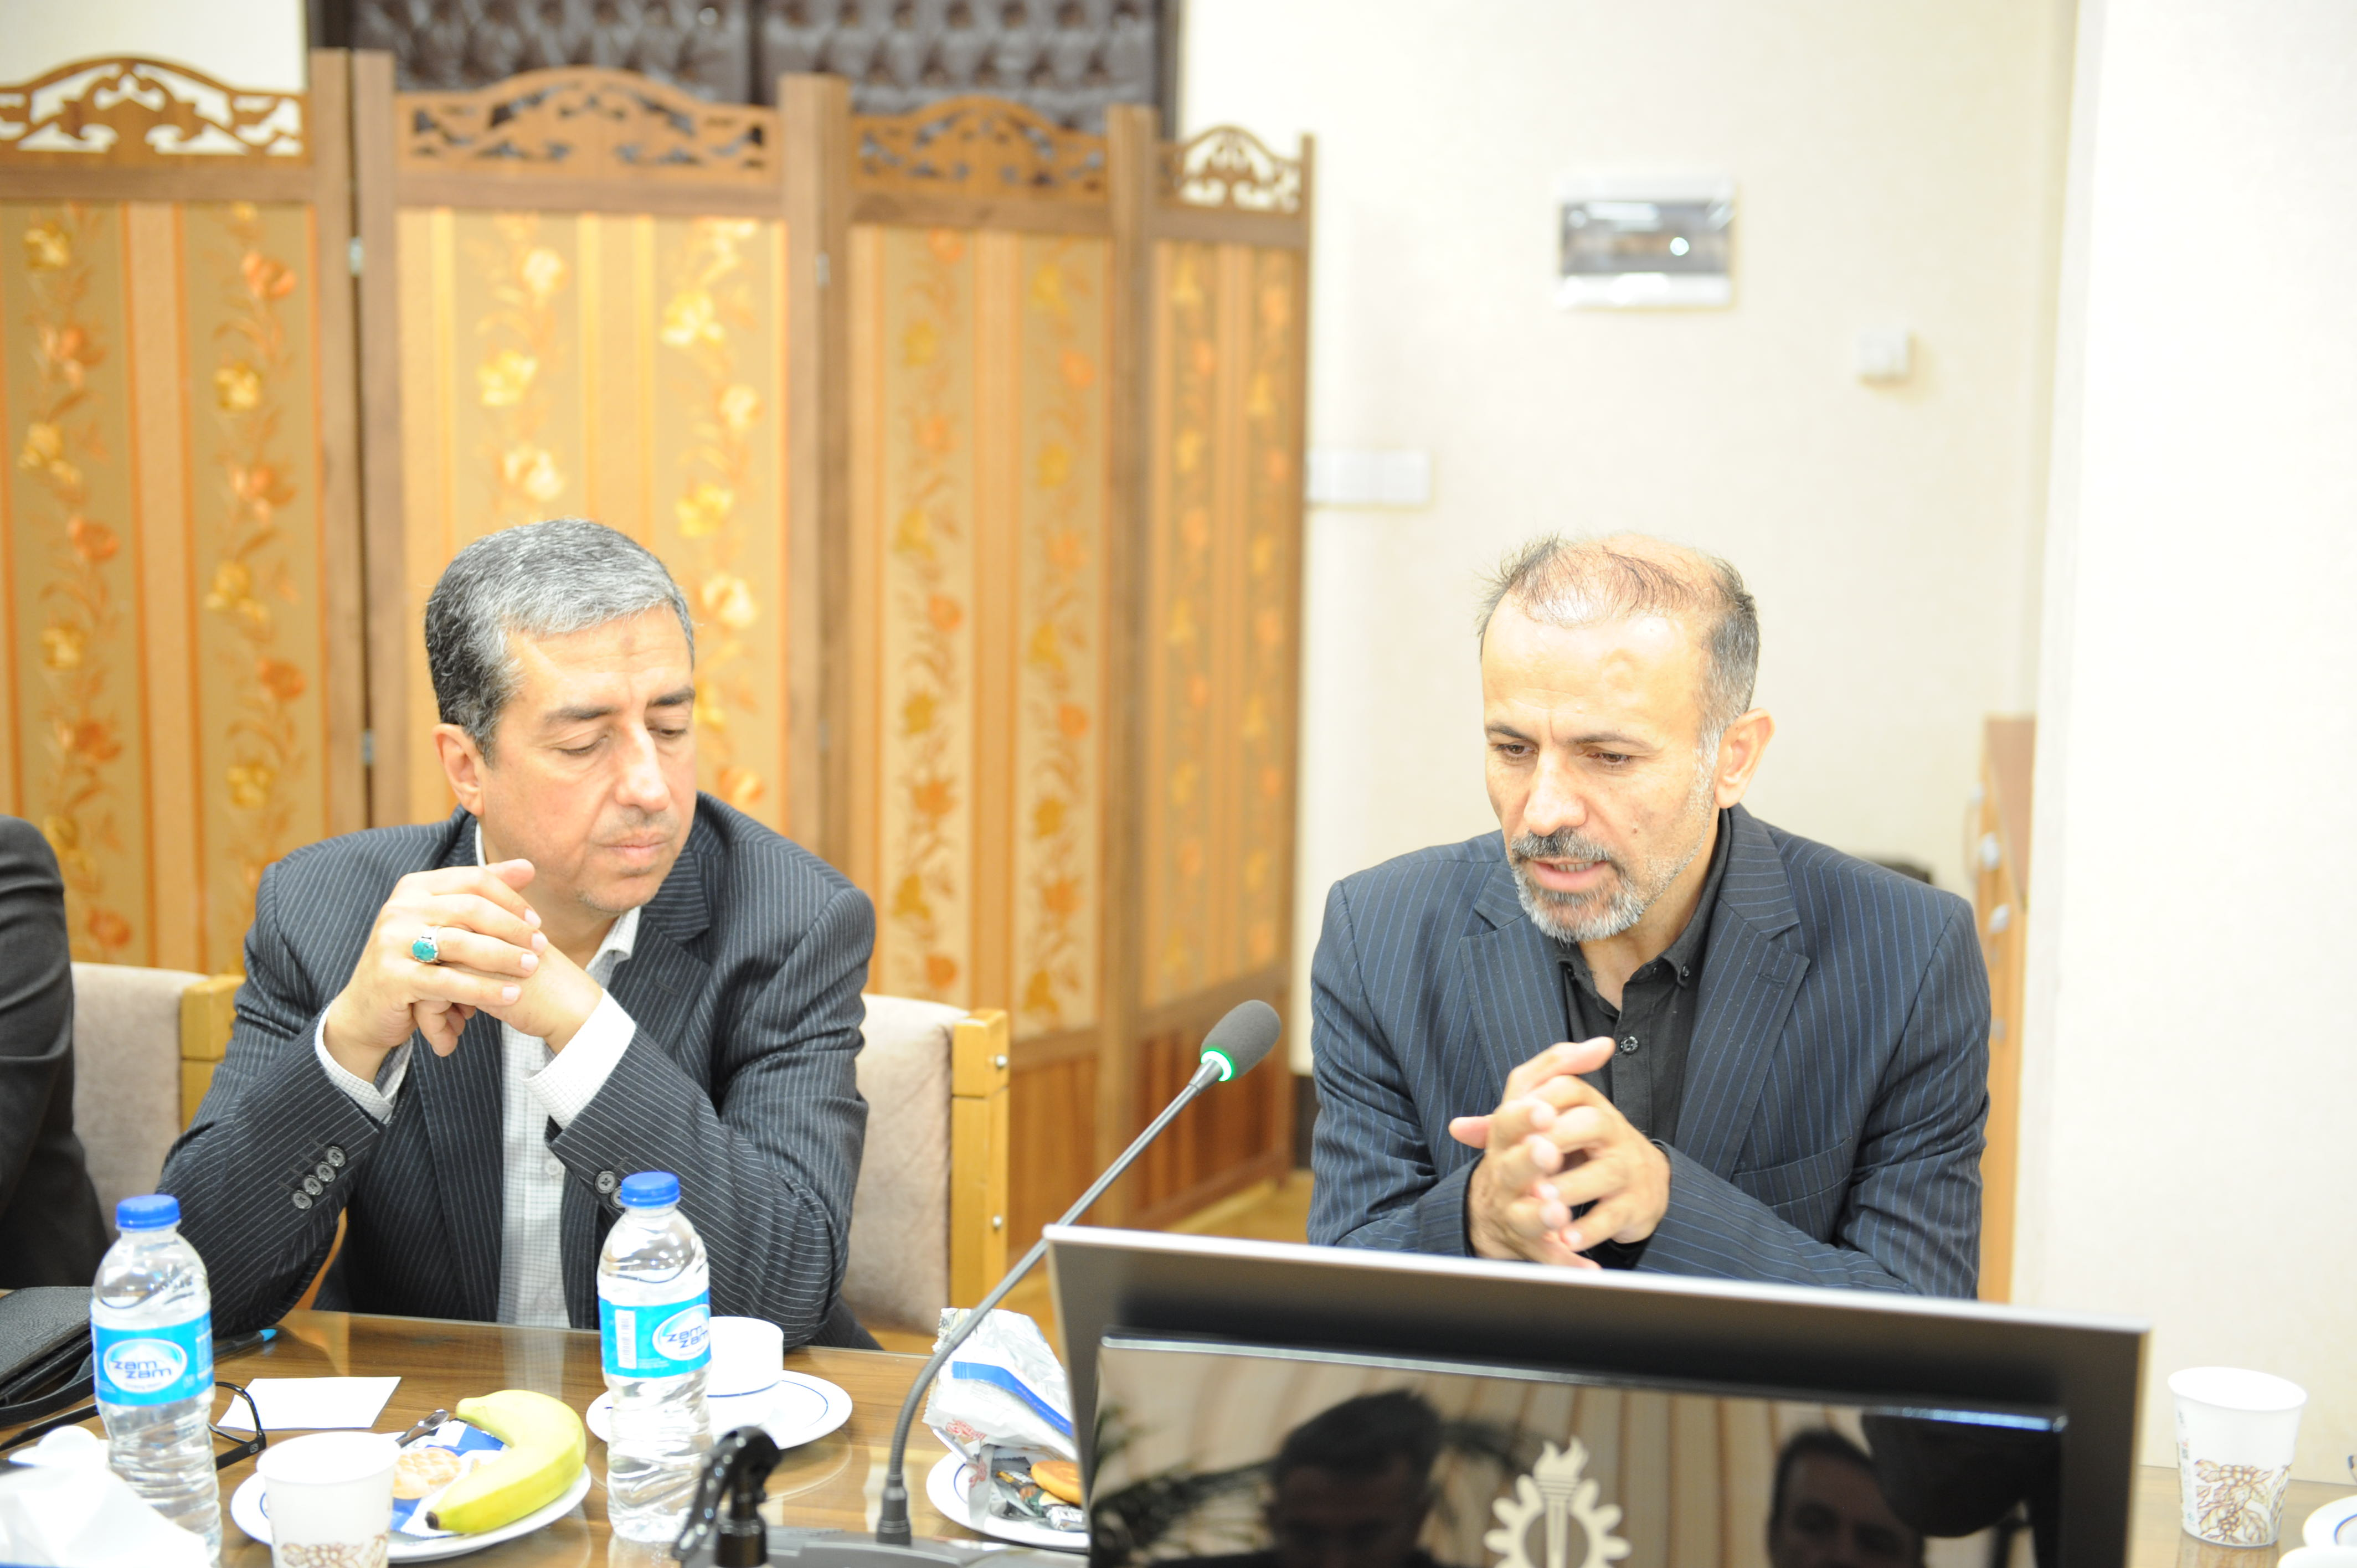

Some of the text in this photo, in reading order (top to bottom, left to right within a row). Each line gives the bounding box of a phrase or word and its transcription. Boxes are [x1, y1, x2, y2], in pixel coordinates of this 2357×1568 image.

[666, 1325, 703, 1342] zam
[113, 1360, 157, 1369] zam
[126, 1368, 172, 1379] zam
